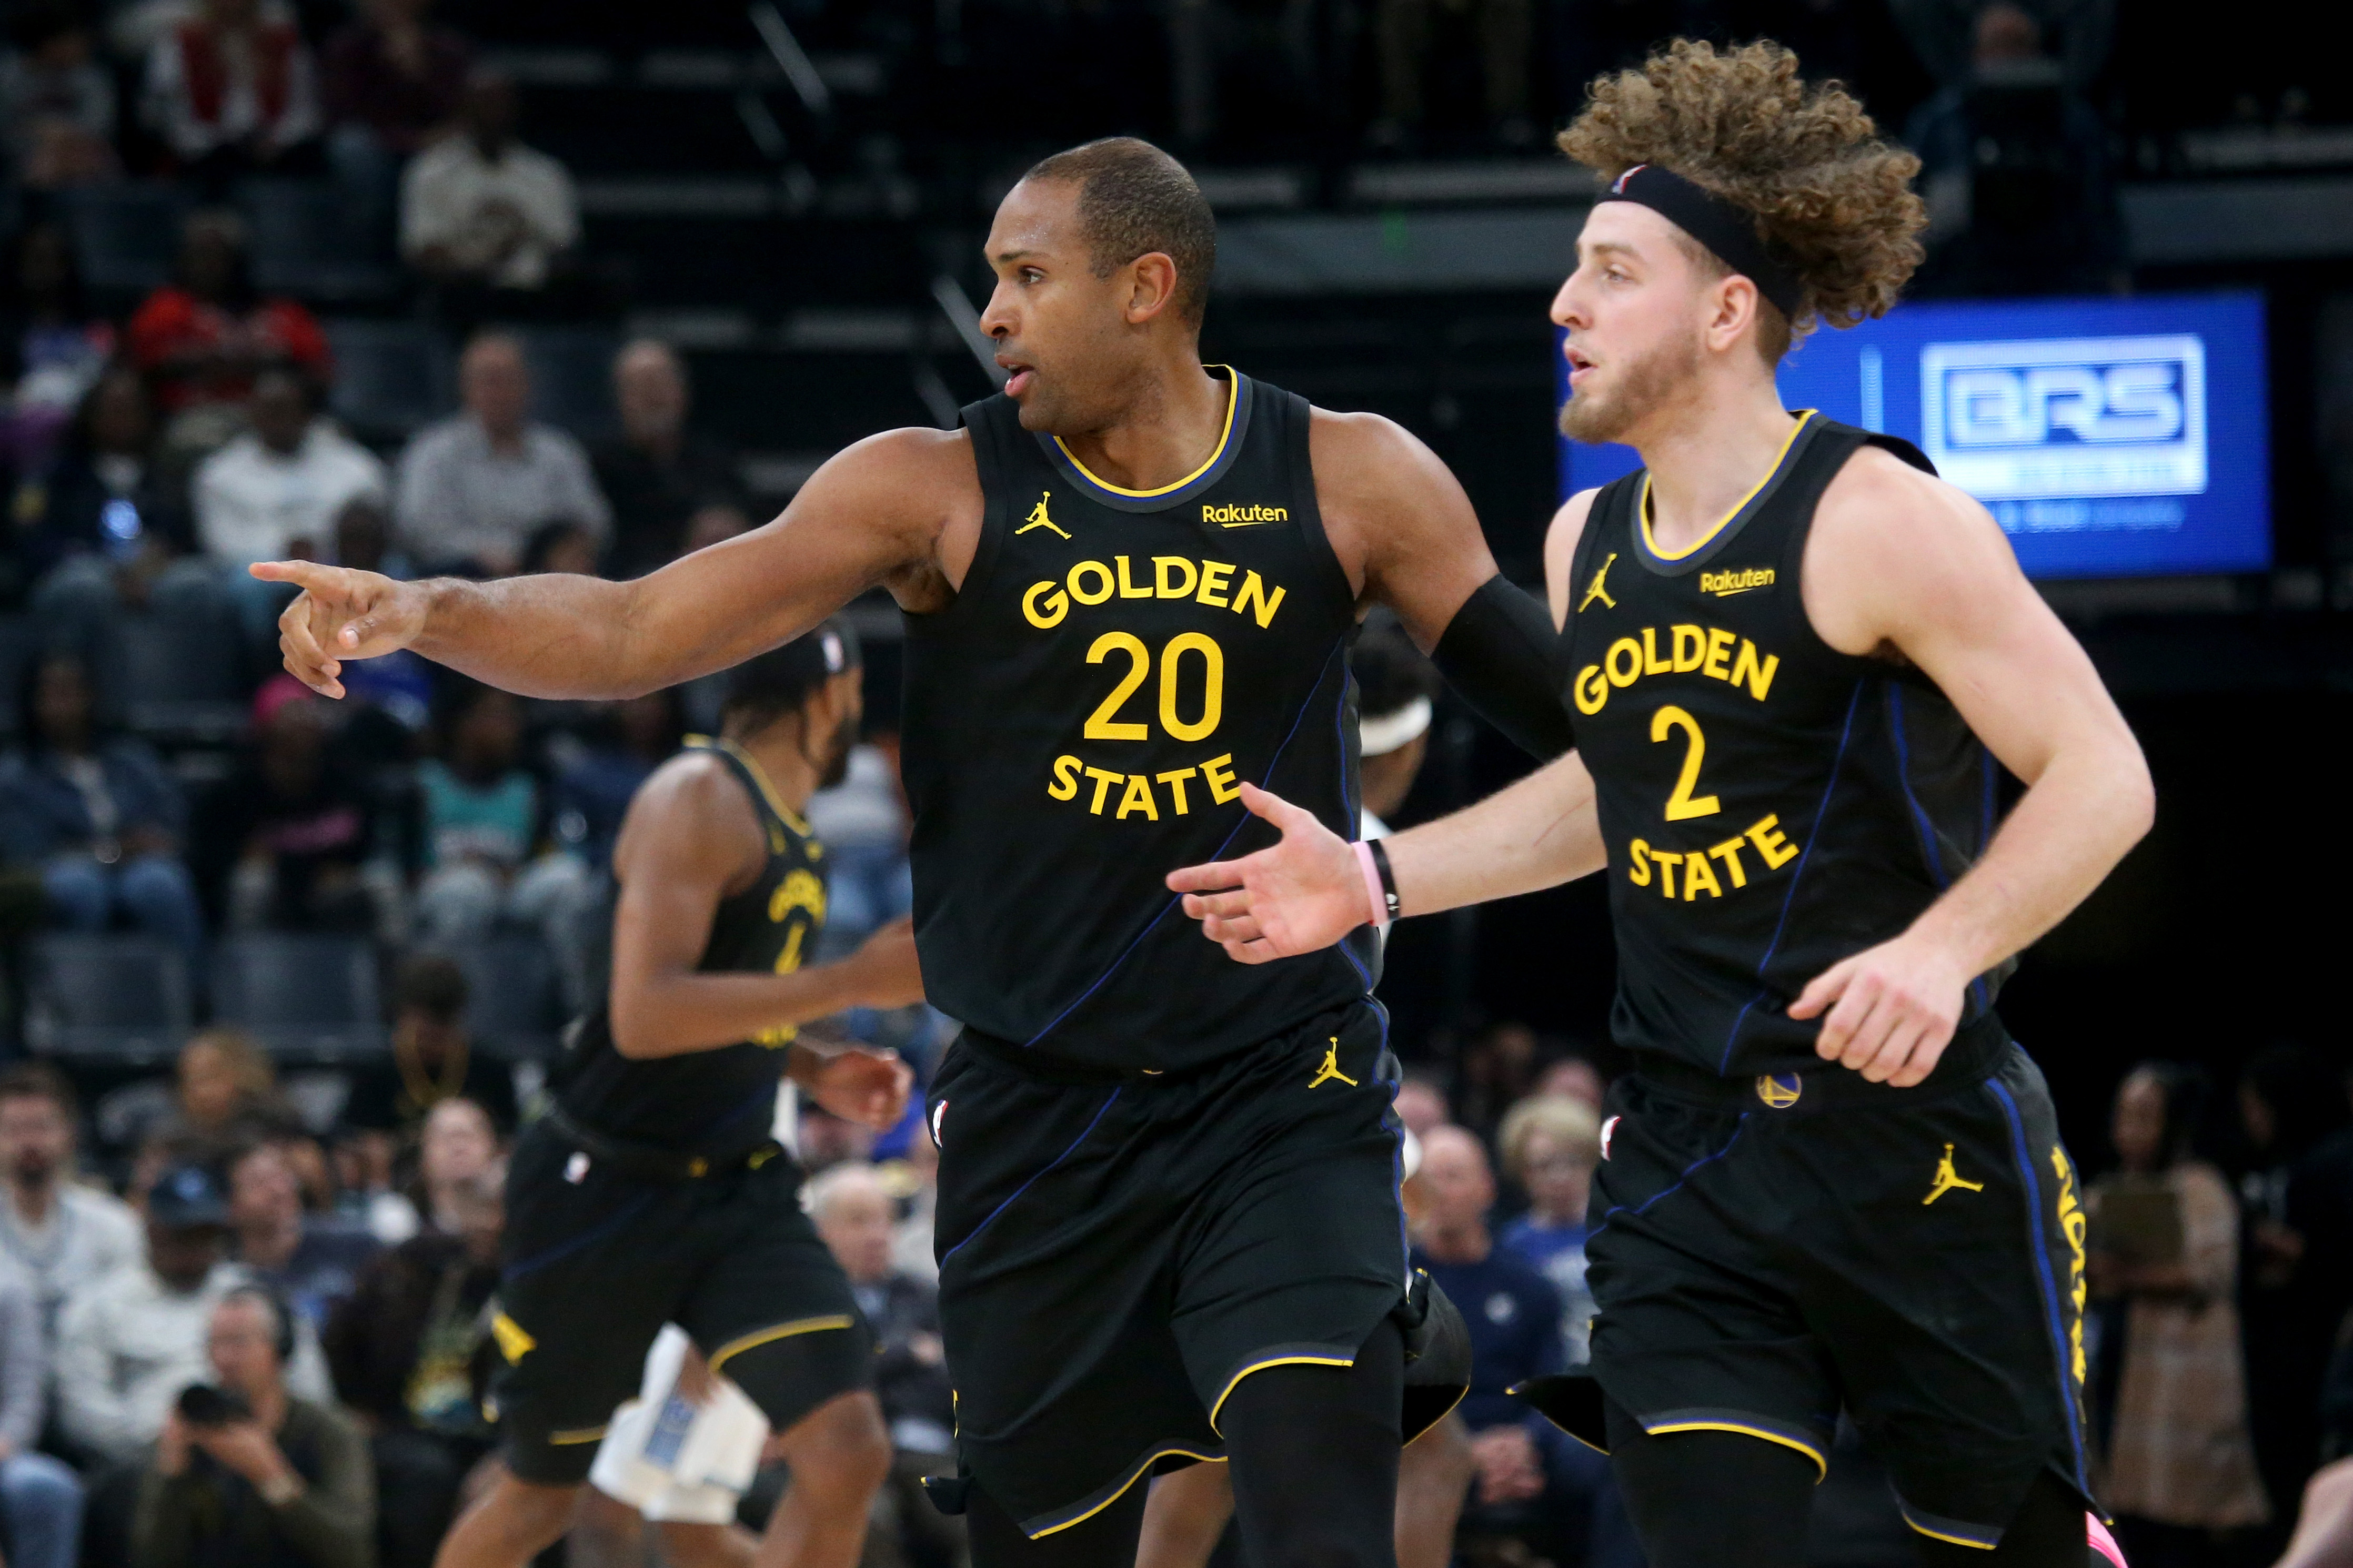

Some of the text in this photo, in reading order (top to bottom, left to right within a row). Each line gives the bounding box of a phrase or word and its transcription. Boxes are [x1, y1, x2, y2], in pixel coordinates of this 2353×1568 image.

[1202, 503, 1288, 523] Rakuten
[1022, 555, 1286, 629] GOLDEN
[1700, 568, 1775, 593] Rakuten
[1083, 631, 1224, 742] 20
[1574, 623, 1780, 715] GOLDEN
[1047, 753, 1241, 821] STATE
[1650, 705, 1721, 822] 2
[1630, 813, 1799, 902] STATE
